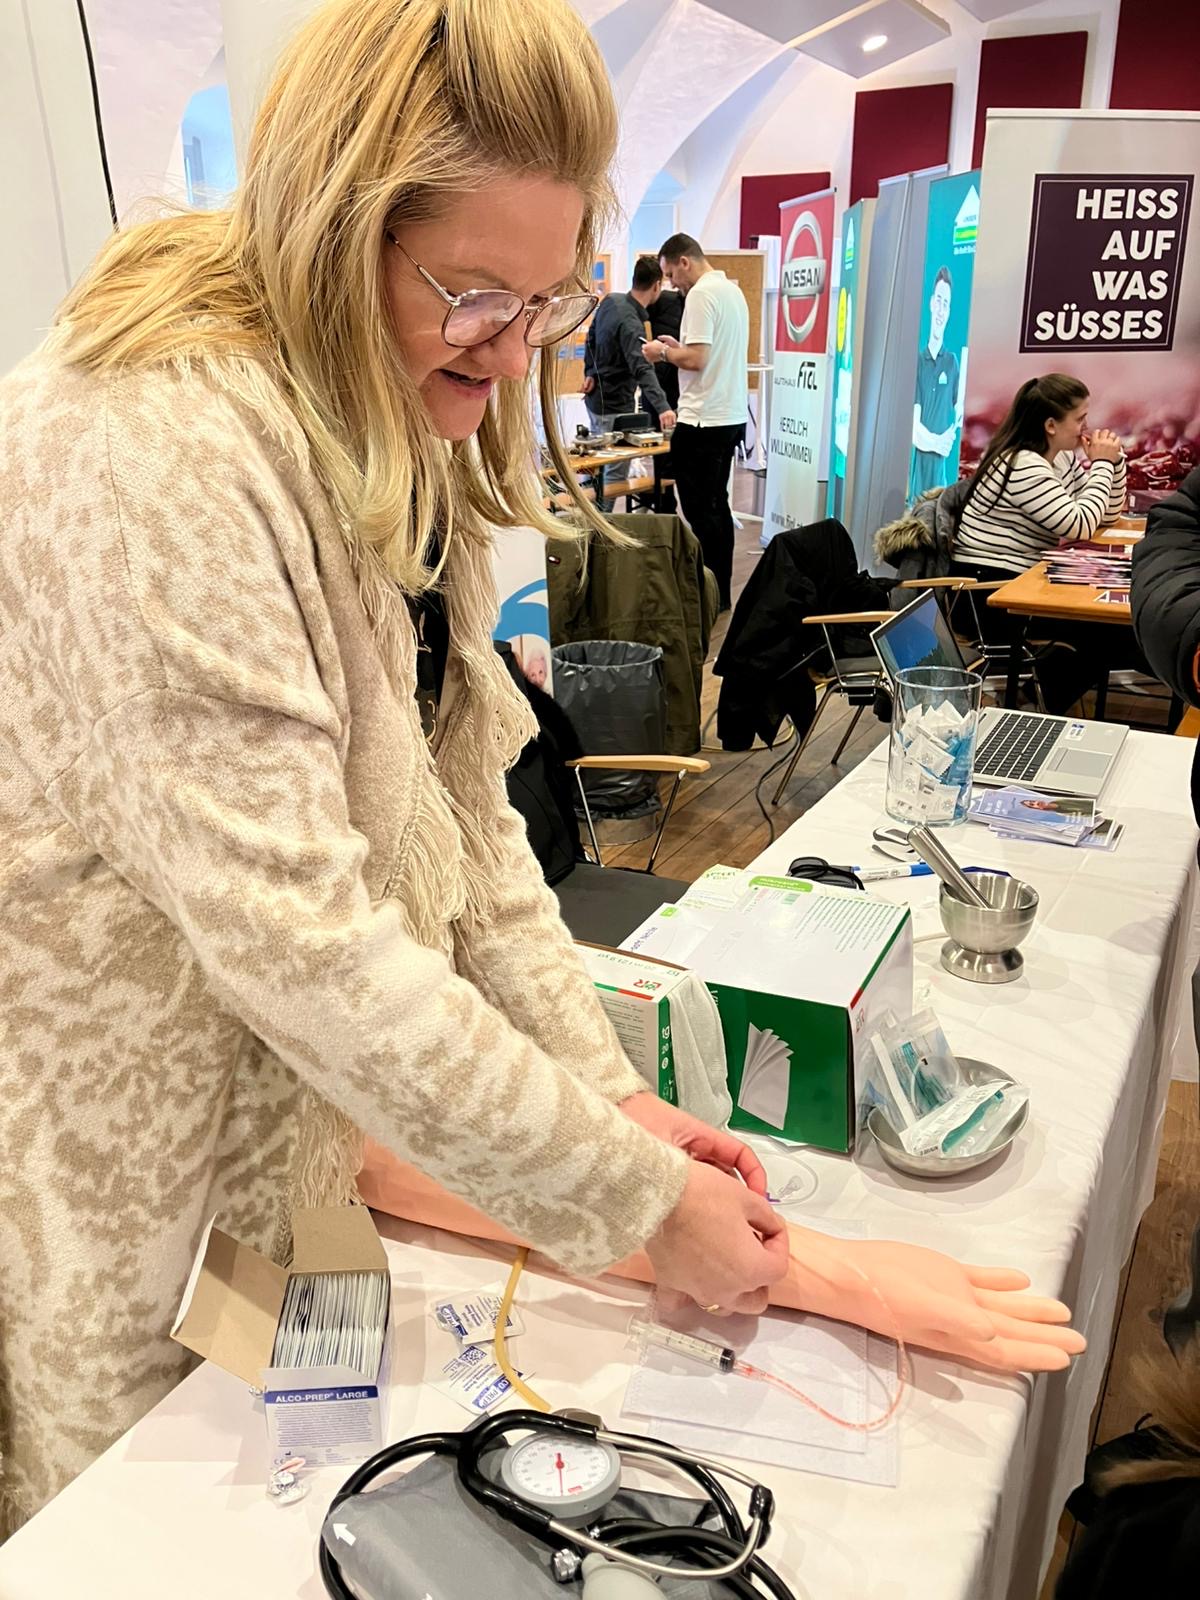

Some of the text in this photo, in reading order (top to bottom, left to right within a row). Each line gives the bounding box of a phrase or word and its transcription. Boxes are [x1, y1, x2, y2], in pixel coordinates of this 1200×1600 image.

[1076, 188, 1179, 220] HEISS
[1101, 230, 1176, 261] AUF
[783, 267, 821, 289] NISSAN
[1092, 270, 1169, 301] WAS
[1034, 303, 1164, 341] SÜSSES
[779, 416, 809, 437] HERZLICH
[771, 438, 813, 465] WILLKOMMEN
[336, 1390, 368, 1400] LARGE
